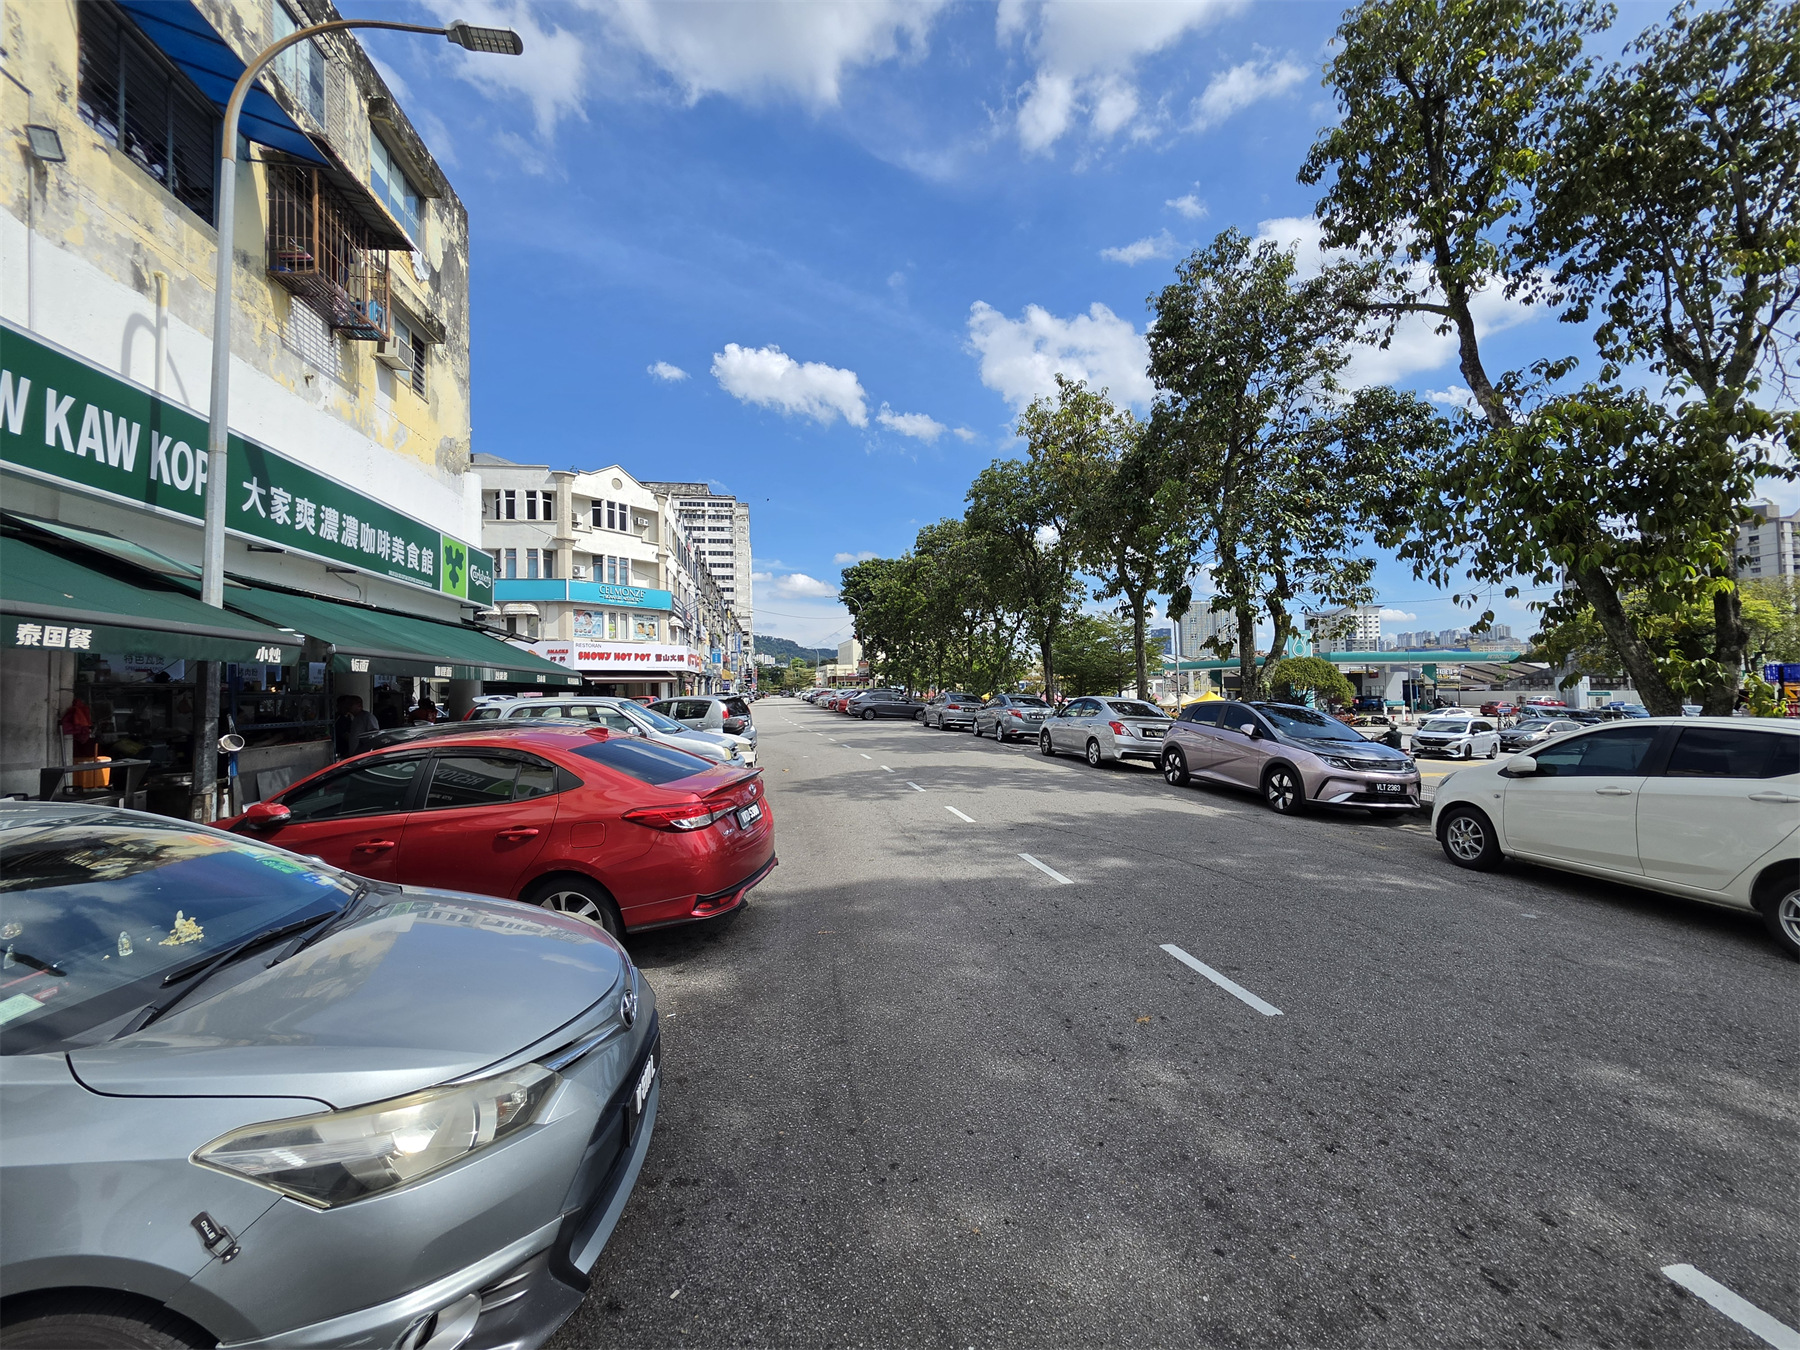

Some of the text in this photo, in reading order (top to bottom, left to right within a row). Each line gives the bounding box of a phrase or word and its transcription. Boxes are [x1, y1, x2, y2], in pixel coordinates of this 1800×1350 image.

[45, 387, 141, 472] KAW
[150, 429, 210, 496] KOP
[241, 476, 434, 576] 大家爽濃濃咖啡美食館
[599, 585, 645, 598] CELMONZE
[16, 623, 93, 650] 泰国餐
[255, 646, 281, 663] 小炒
[578, 651, 612, 661] SNOWY
[614, 652, 632, 662] HOT
[634, 653, 651, 662] POT
[1376, 783, 1387, 791] VLT
